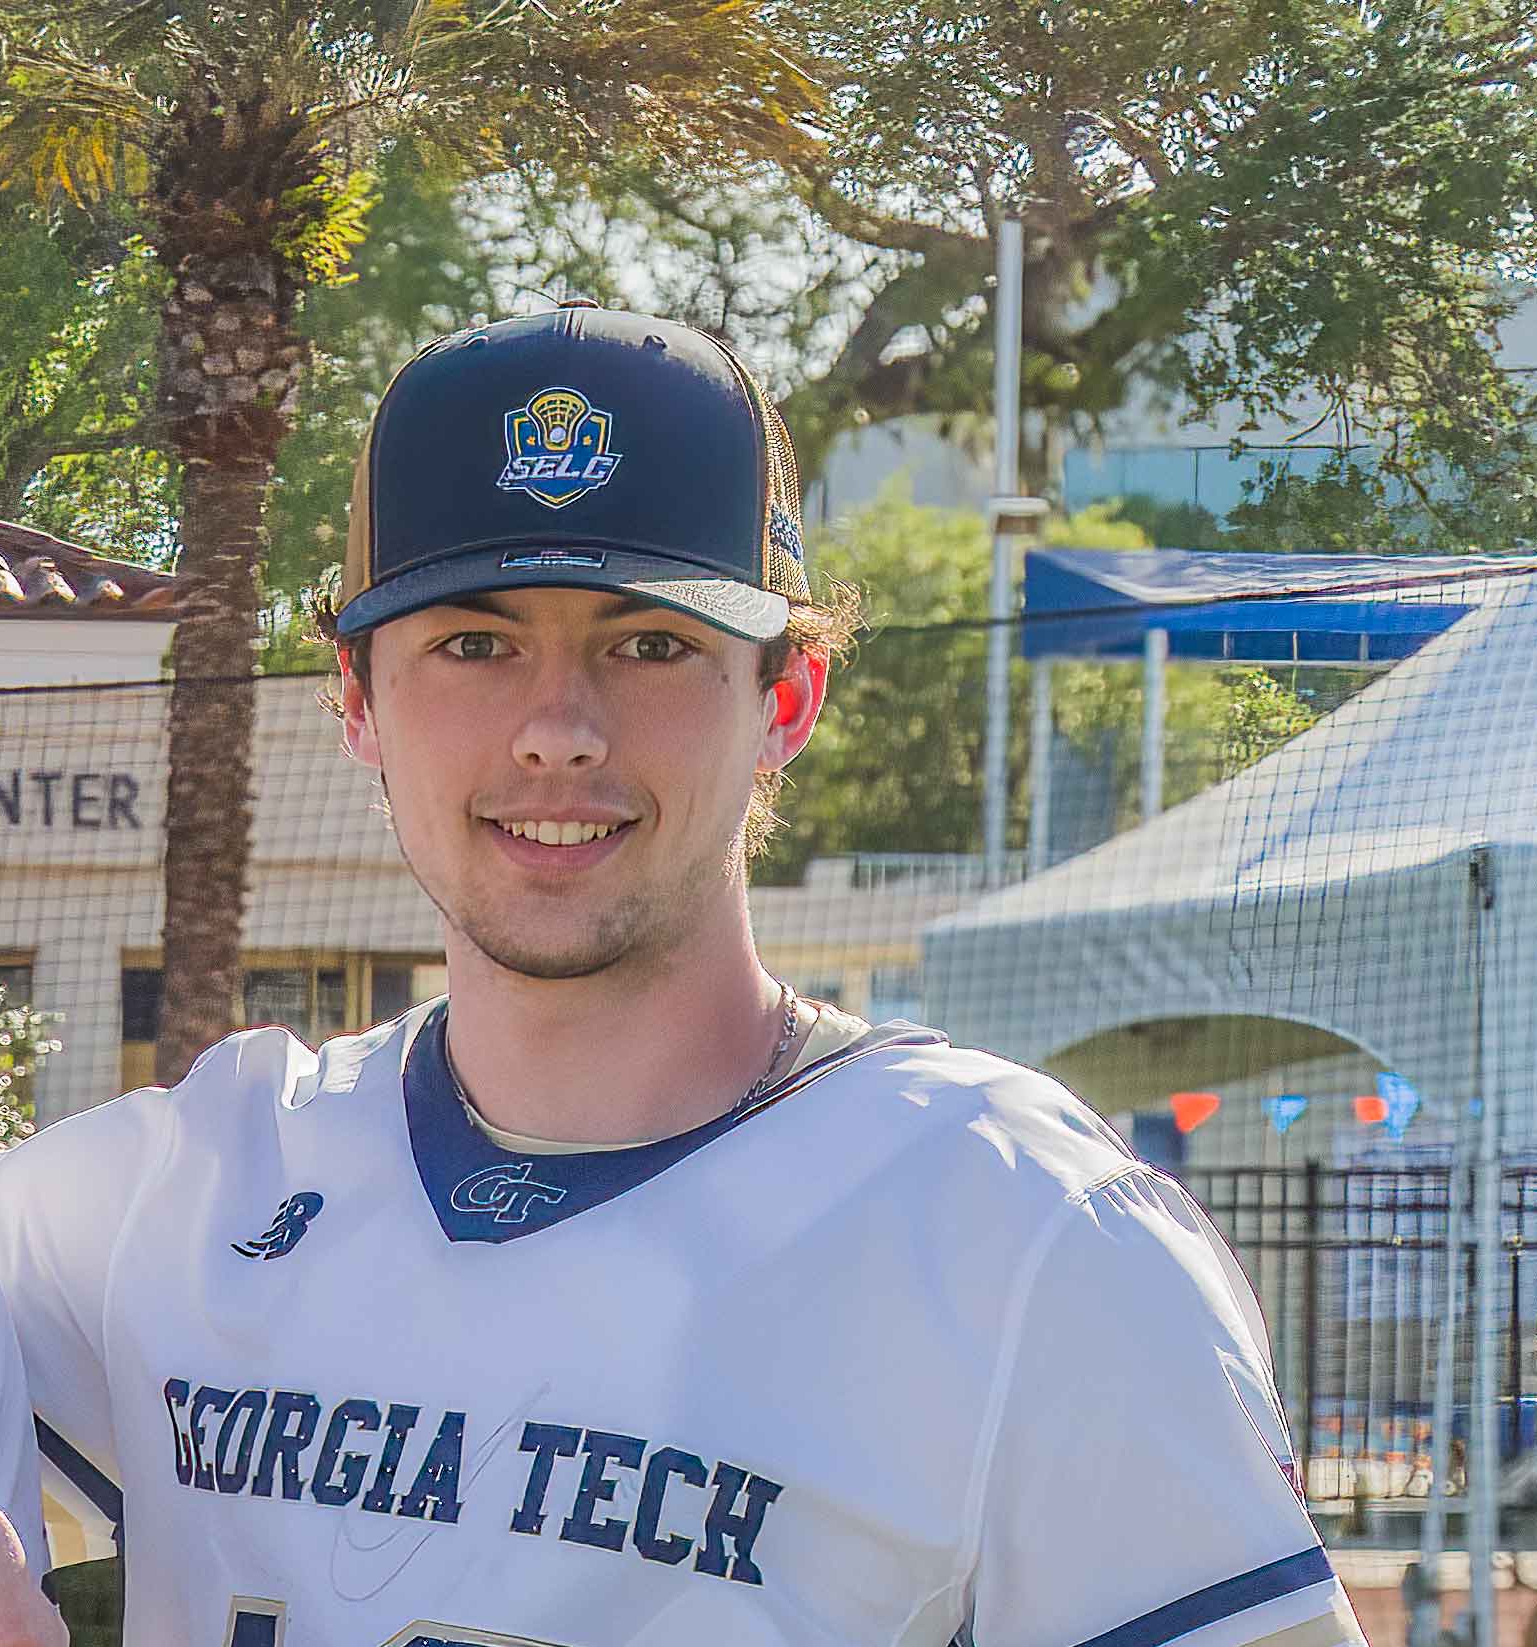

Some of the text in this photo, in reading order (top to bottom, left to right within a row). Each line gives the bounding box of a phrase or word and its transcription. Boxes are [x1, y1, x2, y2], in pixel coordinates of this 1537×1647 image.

[505, 454, 615, 481] SELC
[450, 1163, 567, 1224] GT
[163, 1377, 785, 1587] GEORGIA TECH
